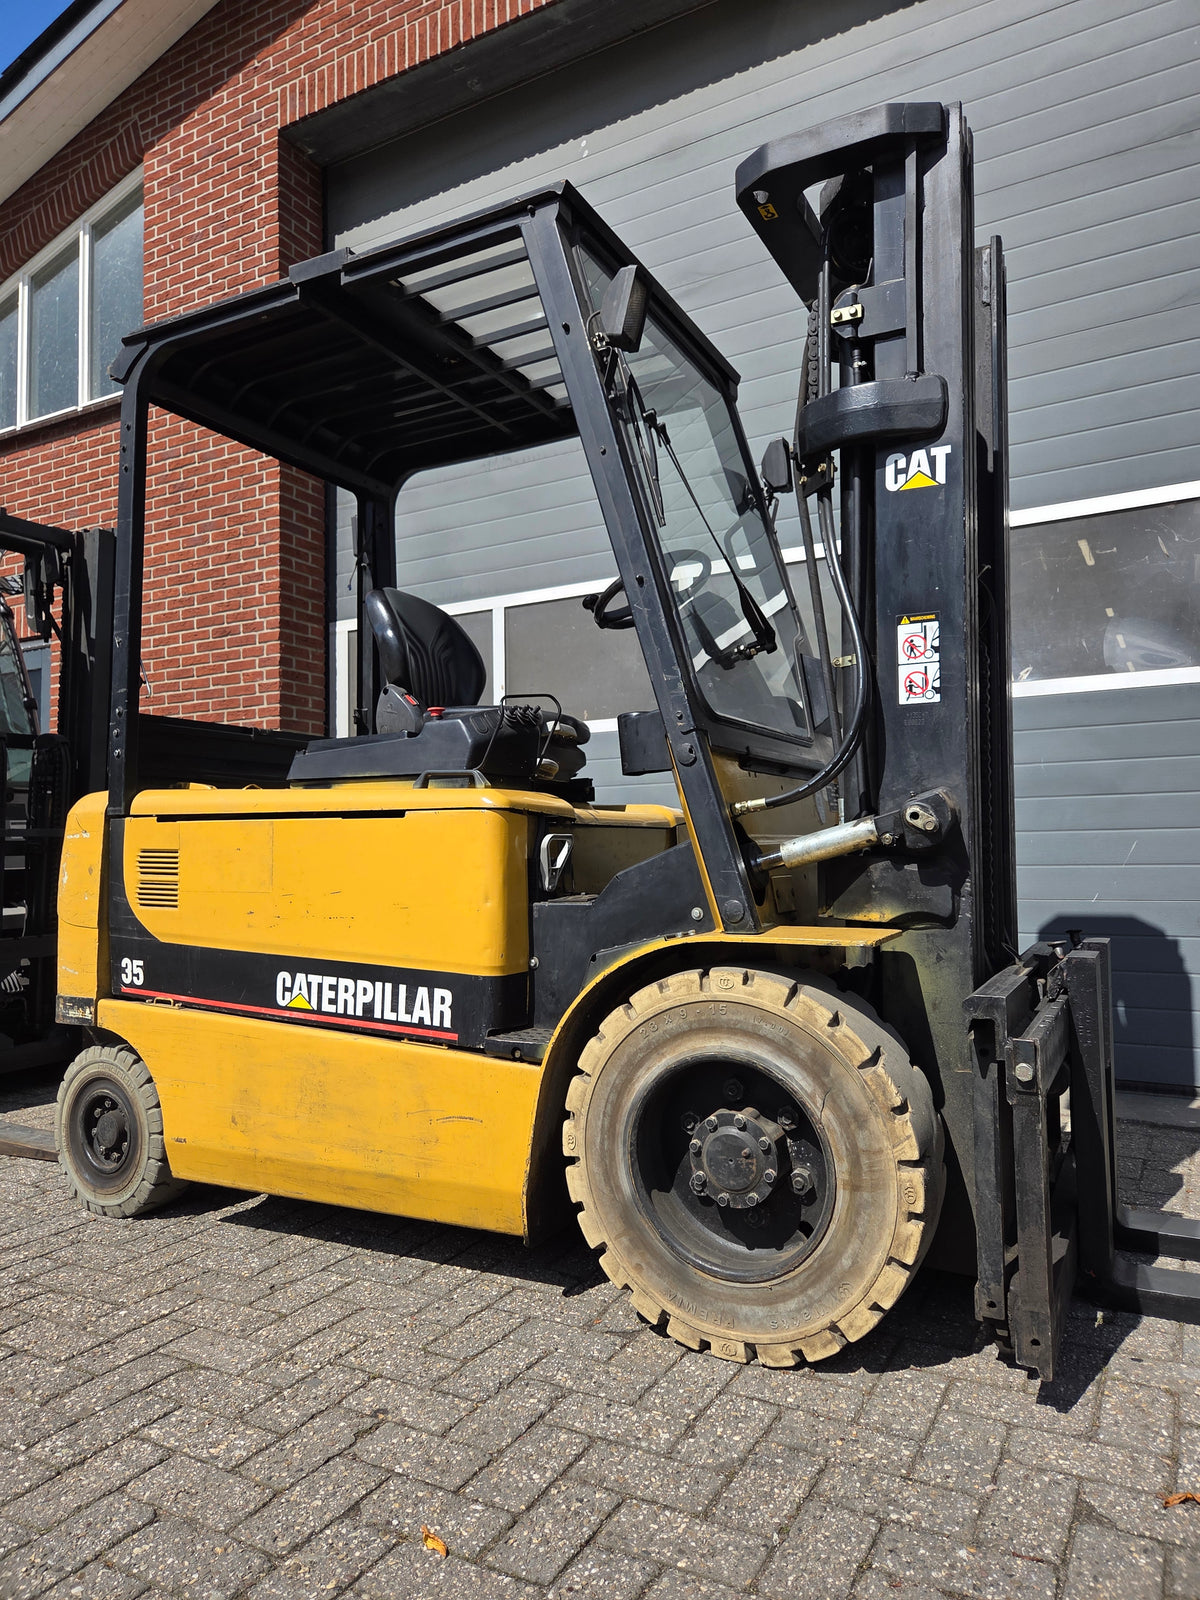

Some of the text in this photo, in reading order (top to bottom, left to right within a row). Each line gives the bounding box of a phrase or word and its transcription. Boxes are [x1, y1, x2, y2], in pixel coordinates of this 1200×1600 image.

[885, 444, 952, 492] CAT
[121, 957, 144, 985] 35
[275, 971, 453, 1028] CATERPILLAR
[679, 1009, 689, 1020] 9
[708, 1003, 728, 1016] 15
